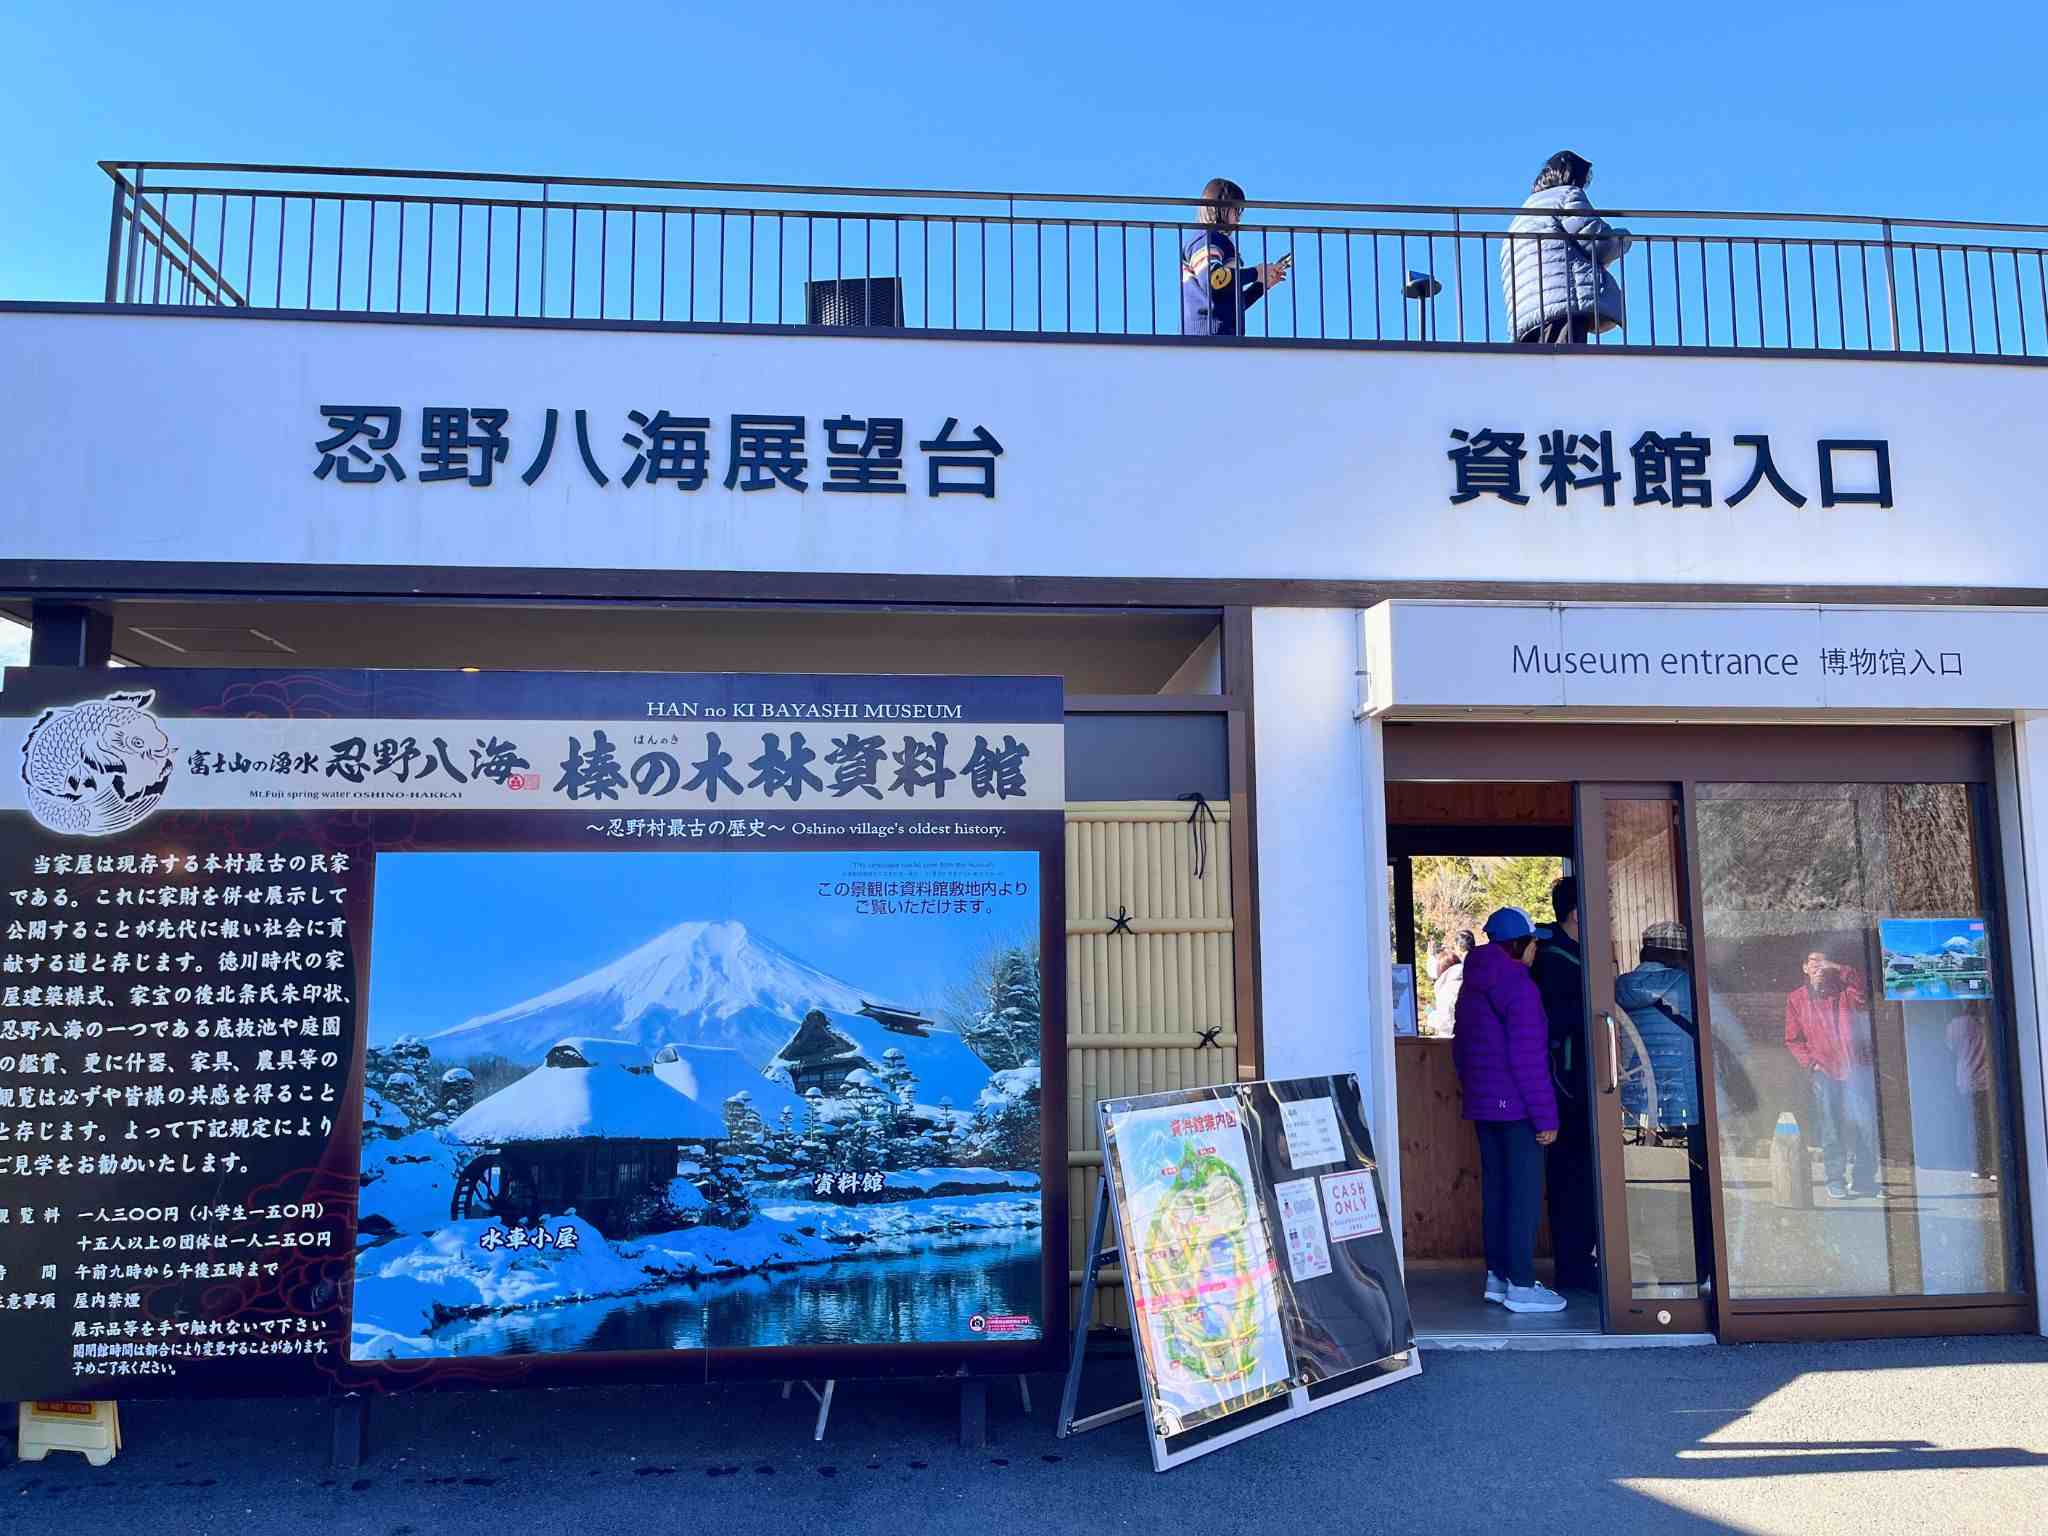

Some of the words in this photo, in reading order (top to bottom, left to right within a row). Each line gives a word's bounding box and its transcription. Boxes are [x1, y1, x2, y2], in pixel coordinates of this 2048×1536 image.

[312, 404, 1004, 499] 忍野八海展望台
[1447, 427, 1894, 509] 資料館入口
[1512, 643, 1650, 675] Museum
[1660, 649, 1799, 676] entrance
[1819, 646, 1963, 678] 博物馆入口
[646, 702, 699, 717] HAN
[704, 706, 727, 718] no
[732, 702, 754, 717] KI
[760, 703, 858, 719] BAYASHI
[863, 704, 963, 719] MUSEUM
[187, 749, 320, 777] 富士山の湧水
[325, 735, 531, 785] 忍野八海
[552, 729, 1030, 803] 榛の木林資料館
[287, 791, 319, 801] spring
[321, 791, 350, 799] water
[352, 791, 463, 799] OSHINO-HAKKAI
[791, 821, 846, 836] Oshino
[848, 822, 905, 839] village's
[908, 822, 951, 835] oldest
[953, 822, 1007, 839] history.
[33, 852, 351, 875] 当家屋は現存する本村最古の民家
[817, 880, 1029, 898] この景観は資料館敷地内より
[855, 899, 993, 915] ご覧いただけます。
[5, 917, 348, 941] 公開することが先代に報い社会に貢
[0, 1015, 341, 1041] 忍野八海の一つである底抜池や庭園
[815, 1171, 885, 1196] 資料館
[1331, 1182, 1366, 1200] CASH
[1335, 1197, 1369, 1216] ONLY
[480, 1226, 579, 1252] 水車小屋
[74, 1261, 279, 1281] 午前九時から午後五時まで
[73, 1291, 141, 1309] 屋内禁煙
[71, 1317, 327, 1338] 展示品等を手で触れないで下さい
